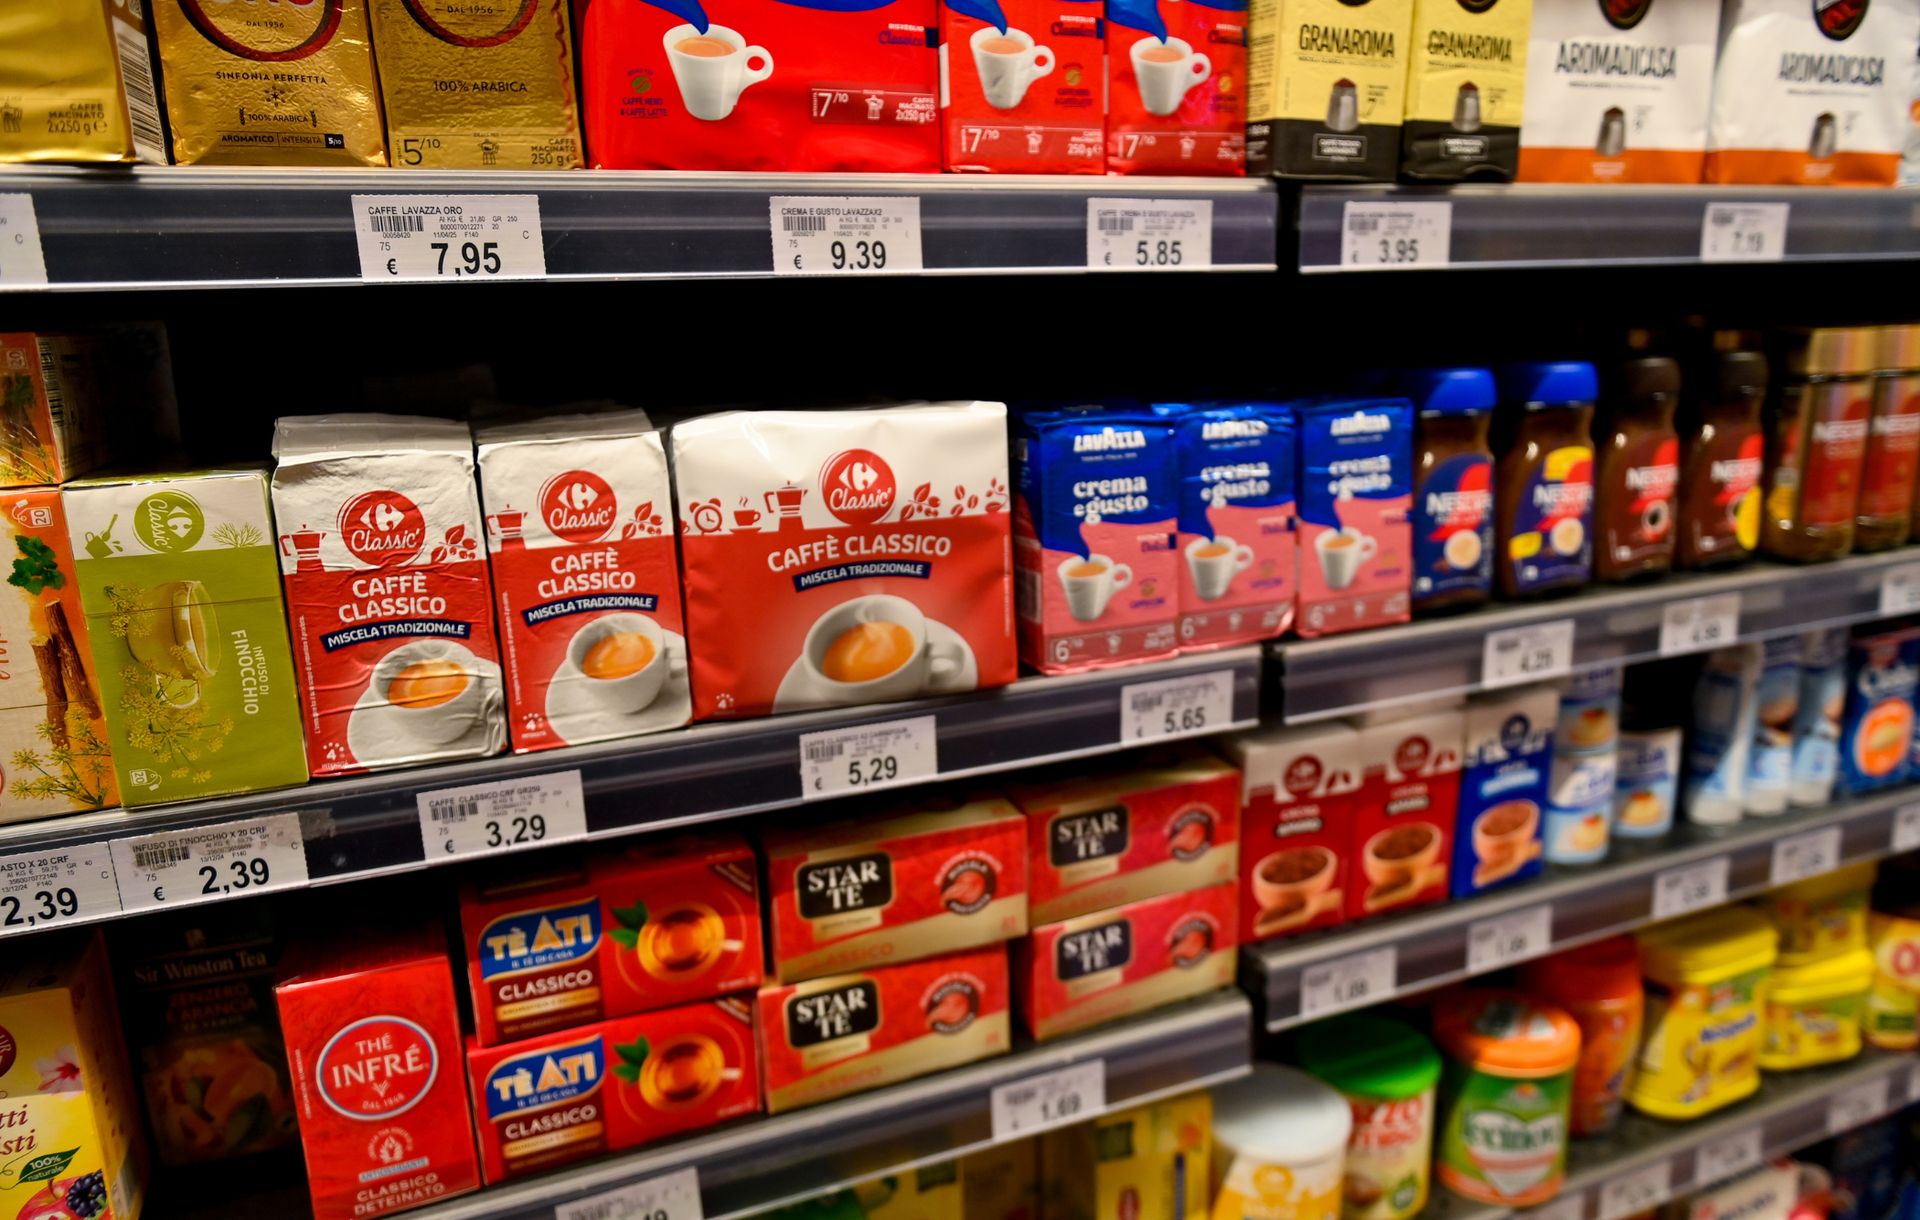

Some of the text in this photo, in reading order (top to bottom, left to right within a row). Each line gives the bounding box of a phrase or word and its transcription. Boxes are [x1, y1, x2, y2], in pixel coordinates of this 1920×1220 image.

[469, 6, 493, 14] 1956
[1299, 23, 1395, 58] GRANAROMA
[1428, 30, 1512, 62] GRANAROMA
[1555, 41, 1677, 79] AROMADICASA
[1778, 51, 1886, 85] AROMADICASA
[216, 71, 328, 85] SINFONIA PERFETTA
[434, 80, 528, 93] 100% ARABICA
[48, 111, 105, 120] MACINATO
[48, 120, 92, 136] 2x250 g
[248, 113, 309, 123] 100% ARABICA
[221, 135, 275, 143] AROMATICO
[530, 145, 577, 153] MACINATO
[531, 153, 564, 167] 250 g
[368, 206, 463, 215] CAFFE LAVAZZA ORO
[781, 207, 808, 216] CREMA
[816, 208, 841, 216] GUSTO
[842, 208, 883, 217] LAVAZZAX2
[14, 233, 24, 245] C
[379, 242, 391, 252] 75
[522, 230, 530, 240] C
[789, 239, 798, 248] 75
[386, 241, 502, 277] € 7,95
[793, 254, 803, 270] €
[1073, 426, 1147, 452] LAVAZZA
[1072, 475, 1148, 499] crema
[32, 508, 49, 526] 20
[1073, 494, 1149, 526] e gusto
[550, 546, 619, 575] CAFFÈ
[767, 533, 951, 573] CAFFÈ CLASSICO
[351, 571, 428, 599] CAFFÈ
[537, 571, 636, 599] CLASSICO
[801, 563, 923, 588] MISCELA TRADIZIONALE
[338, 596, 447, 623] CLASSICO
[527, 596, 653, 622] MISCELA TRADIZIONALE
[327, 622, 466, 648] MISCELA TRADIZIONALE
[230, 629, 260, 716] FINOCCHIO
[252, 646, 270, 696] INFUSO DI
[525, 719, 536, 731] 4
[326, 749, 337, 760] 4
[133, 770, 146, 785] 20
[814, 777, 823, 791] €
[428, 797, 455, 807] CAFFE
[458, 791, 499, 804] CLASSICO
[438, 828, 448, 836] 75
[444, 814, 547, 854] € 3,29
[1057, 811, 1120, 843] STAR
[132, 840, 167, 855] INFUSO
[179, 832, 228, 846] FINOCCHIO
[229, 830, 237, 839] X
[238, 828, 248, 837] 20
[249, 825, 268, 835] CRF
[290, 841, 299, 850] C
[1076, 833, 1105, 860] TE
[15, 869, 27, 877] KG
[41, 865, 59, 874] 59,75
[28, 860, 36, 869] X
[37, 858, 49, 867] 20
[50, 855, 70, 865] CRF
[1, 870, 110, 894] 13/12/24 F140 C
[145, 872, 158, 882] 75
[153, 886, 166, 901] €
[199, 857, 271, 895] 2,39
[807, 860, 881, 894] STAR
[0, 887, 79, 927] 2,39
[825, 884, 865, 911] TE
[1062, 924, 1123, 959] STAR
[134, 949, 269, 983] Sir Winston Tea
[1079, 948, 1107, 973] TE
[498, 969, 594, 1002] CLASSICO
[796, 987, 868, 1024] STAR
[816, 1011, 852, 1040] TE
[354, 1032, 393, 1056] THÉ
[332, 1042, 425, 1089] INFRÉ
[504, 1103, 598, 1140] CLASSICO
[27, 1164, 65, 1182] naturale
[30, 1154, 62, 1170] 100%
[354, 1183, 446, 1216] DETEINATO
[357, 1172, 438, 1202] CLASSICO
